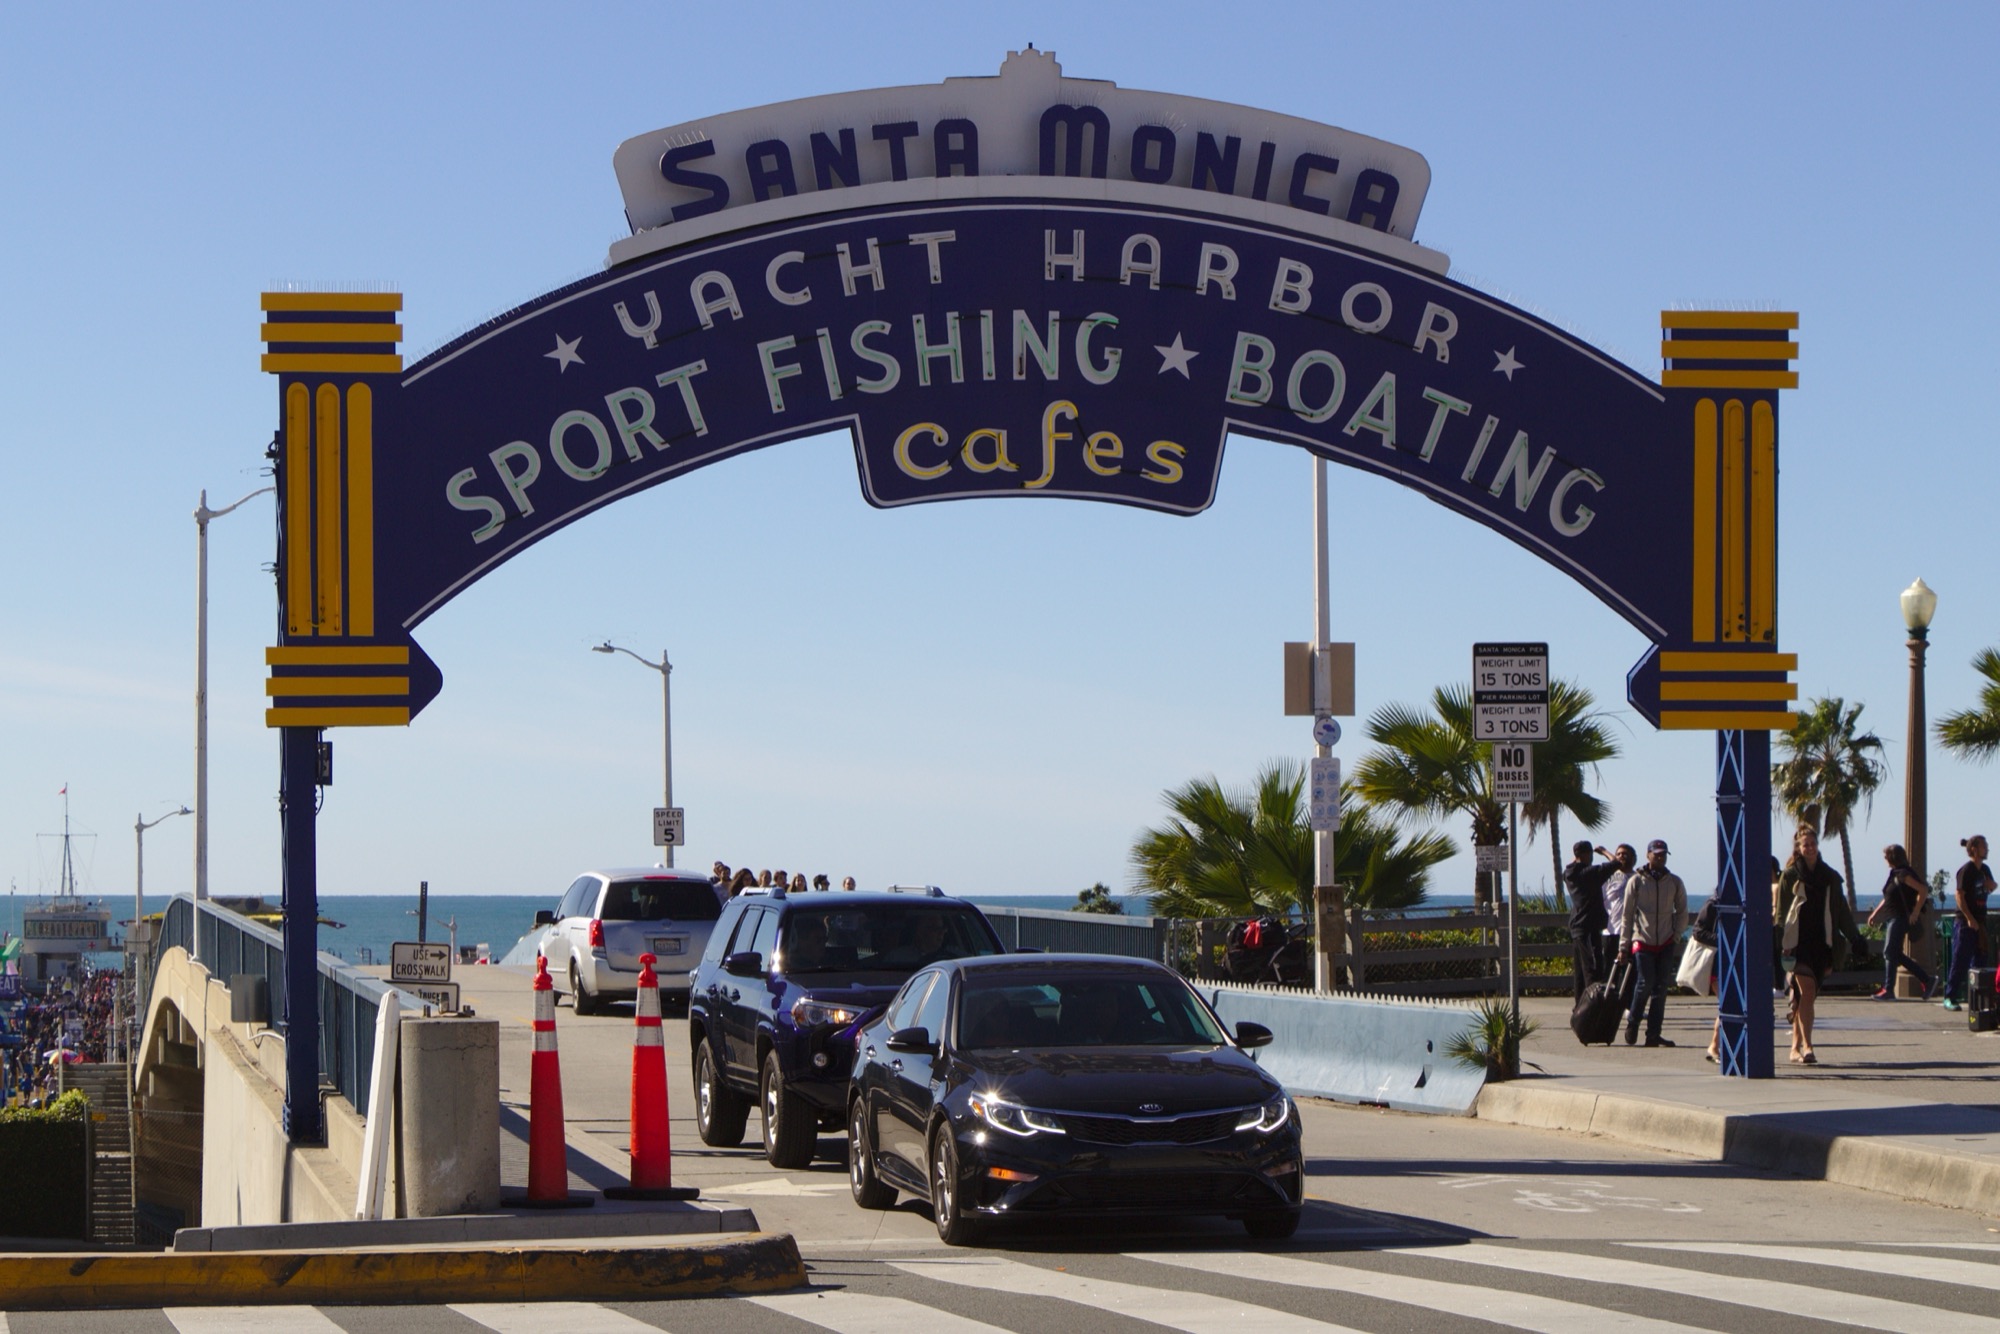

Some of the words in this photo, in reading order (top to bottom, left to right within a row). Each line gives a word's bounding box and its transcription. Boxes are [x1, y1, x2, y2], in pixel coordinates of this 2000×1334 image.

[659, 118, 980, 221] SANTA
[1038, 103, 1401, 232] MONICA
[613, 229, 957, 350] YACHT
[1044, 228, 1460, 364] HARBOR
[445, 358, 709, 545] SPORT
[756, 308, 1123, 415] FISHING
[1224, 330, 1606, 538] BOATING
[1481, 659, 1514, 668] WEIGHT
[1519, 659, 1541, 668] LIMIT
[1481, 672, 1496, 686] 15
[1502, 672, 1541, 686] TONS
[1481, 706, 1514, 715] WEIGHT
[1519, 706, 1541, 715] LIMIT
[1485, 720, 1494, 733] 3
[1500, 720, 1539, 733] TONS
[1501, 748, 1525, 768] NO
[1497, 771, 1529, 782] BUSES
[664, 828, 675, 842] 5
[413, 949, 429, 961] USE
[395, 963, 446, 977] CROSSWALK
